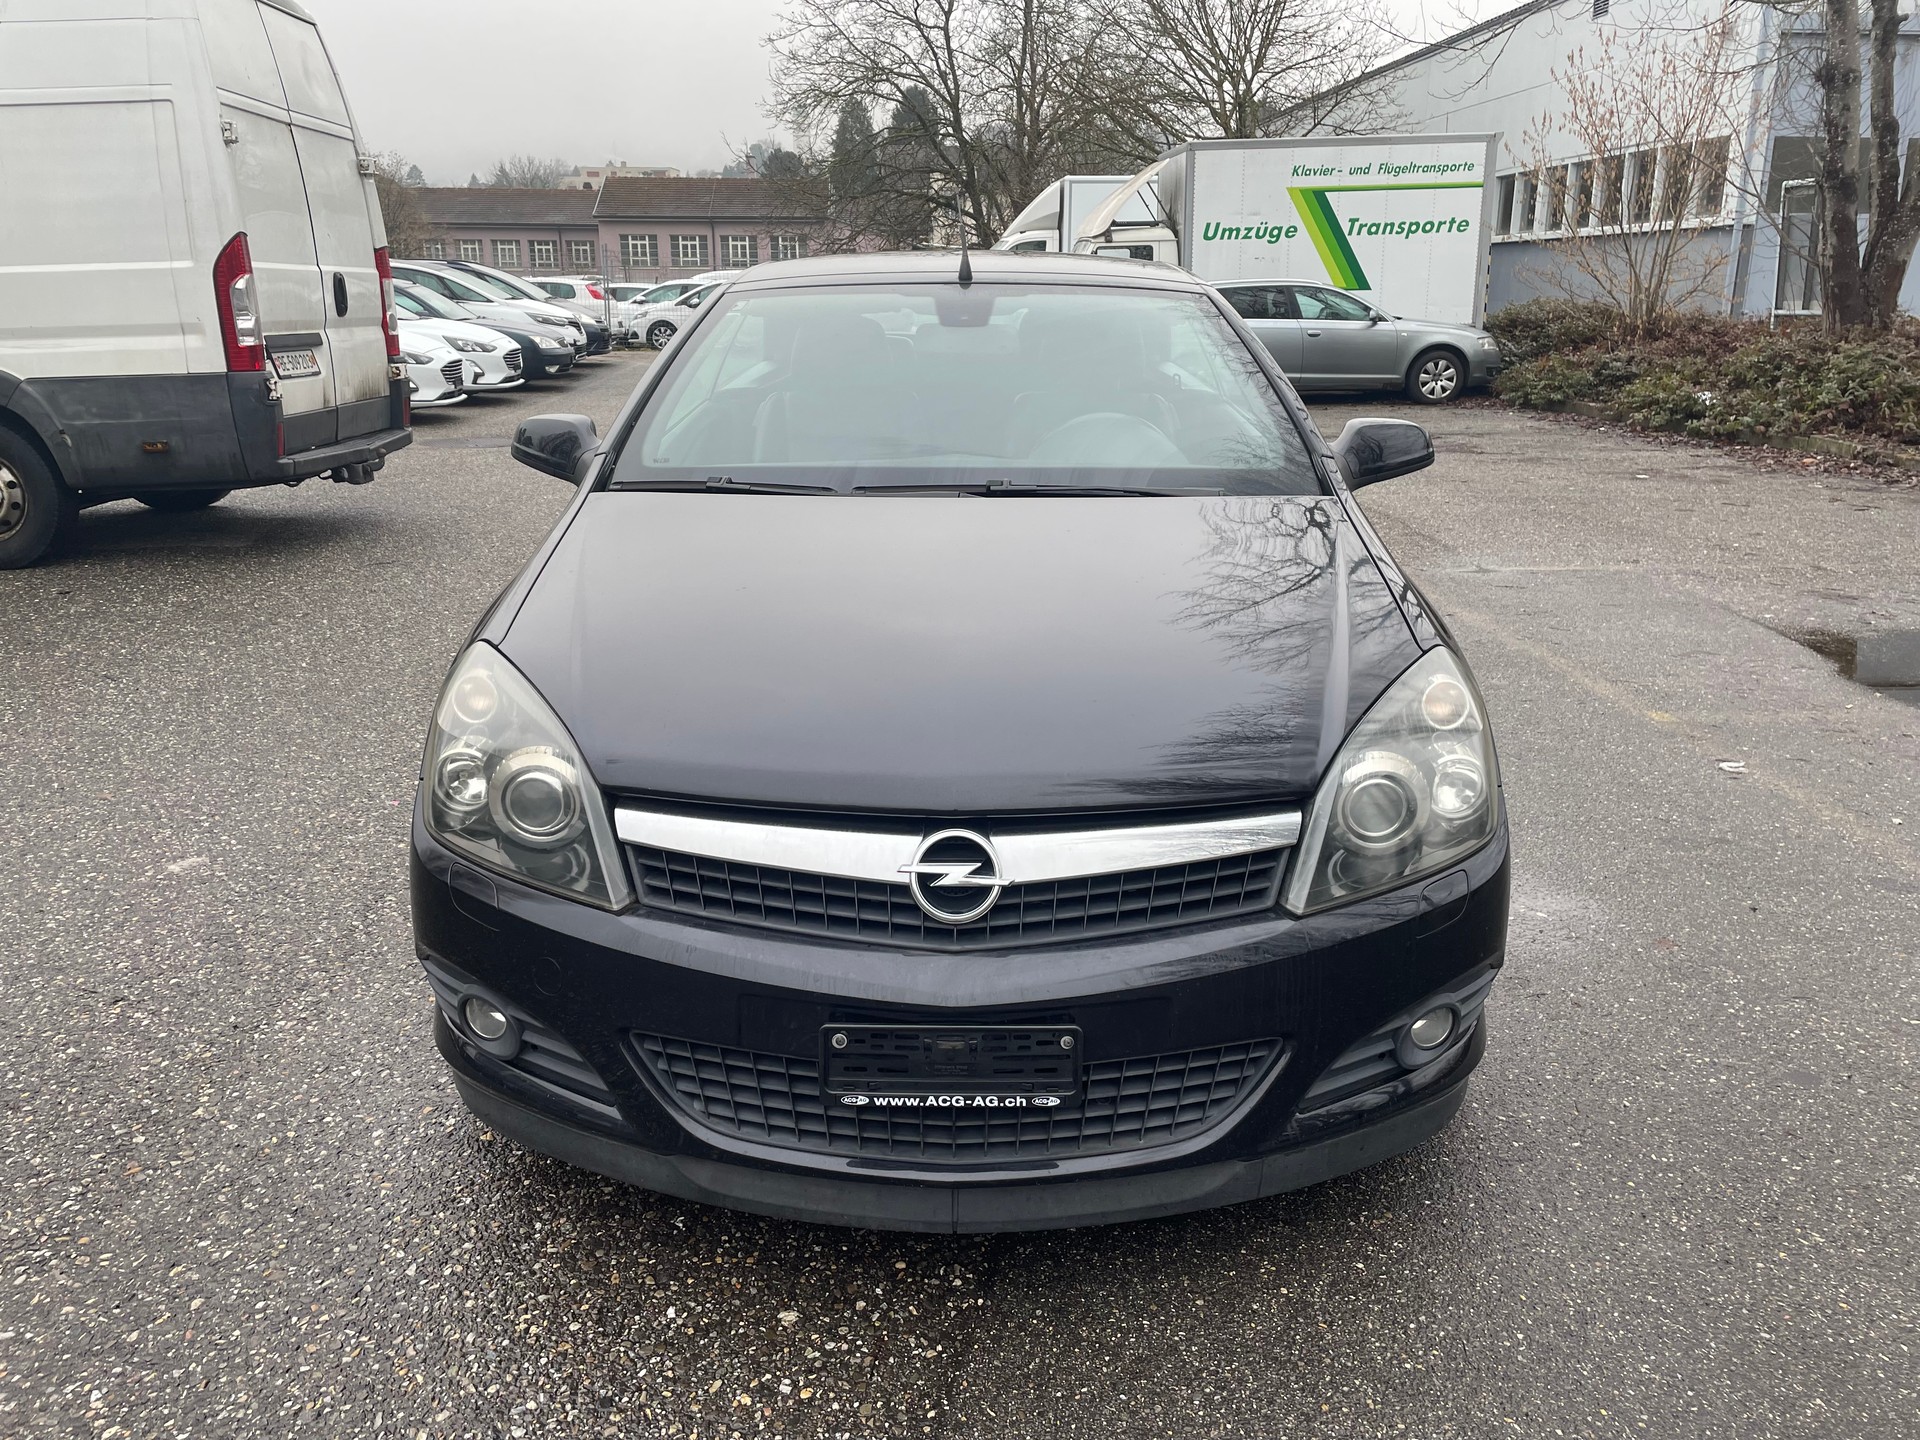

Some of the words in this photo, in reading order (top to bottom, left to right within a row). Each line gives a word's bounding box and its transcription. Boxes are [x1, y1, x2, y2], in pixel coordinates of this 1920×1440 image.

[1349, 163, 1372, 176] und
[1377, 161, 1475, 178] Flügeltransporte
[1202, 221, 1298, 244] Umzüge
[1347, 217, 1470, 240] Transporte
[873, 1095, 1027, 1107] www.ACG-AG.ch
